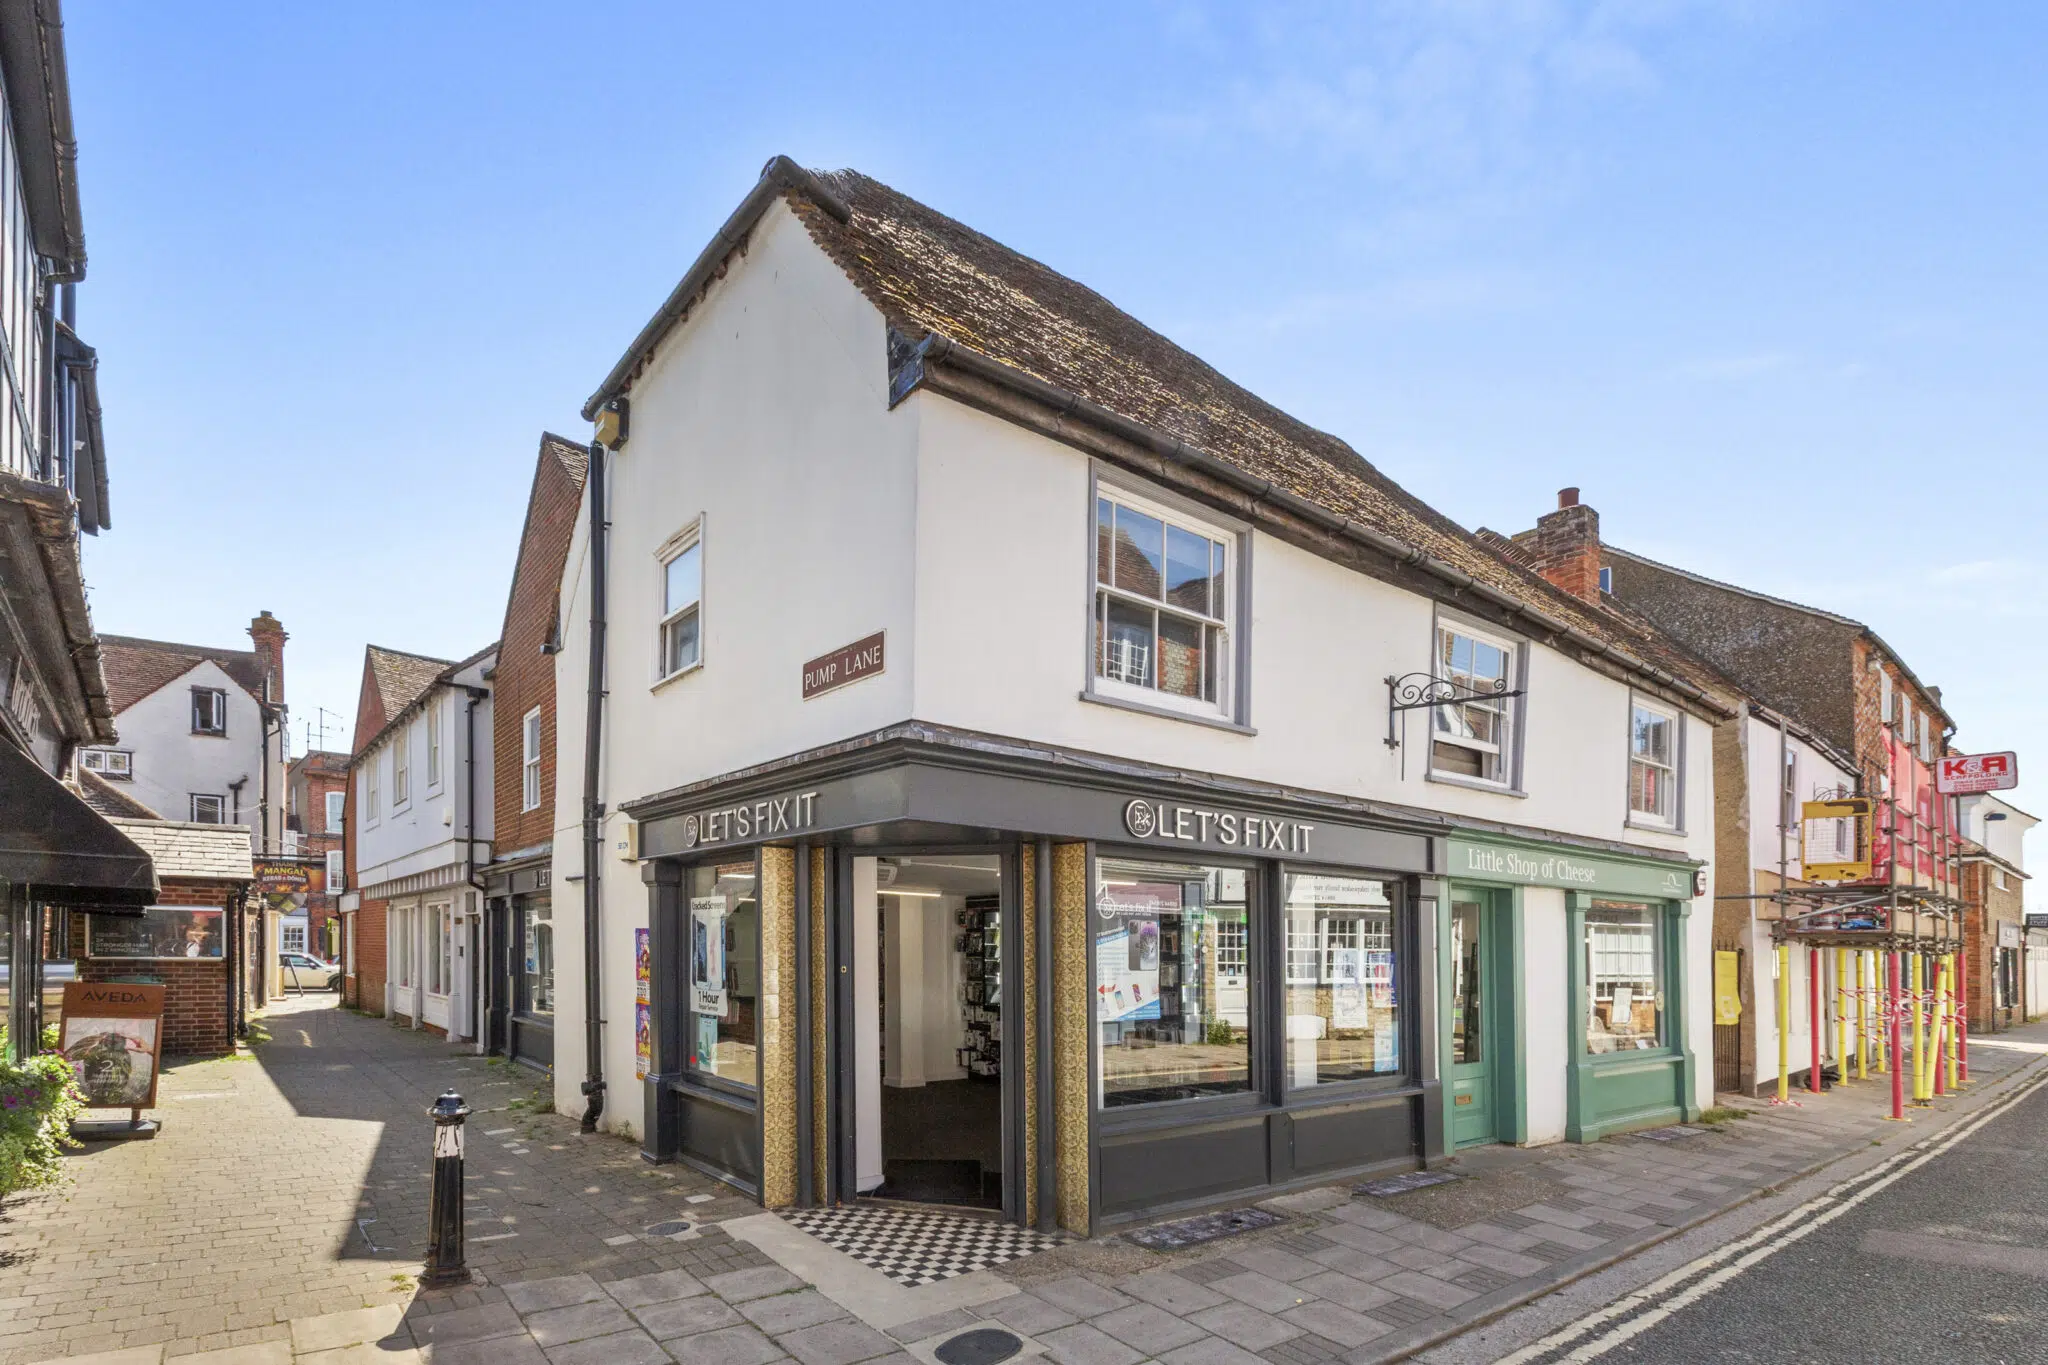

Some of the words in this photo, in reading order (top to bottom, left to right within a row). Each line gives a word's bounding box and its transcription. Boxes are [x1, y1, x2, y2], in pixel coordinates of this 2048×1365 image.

[805, 663, 837, 690] PUMP
[845, 645, 881, 675] LANE
[1944, 756, 2008, 777] K&A
[1944, 772, 2008, 781] SCAFFOLDING
[699, 806, 750, 843] LET'S
[755, 797, 789, 834] FIX
[795, 791, 817, 828] IT
[1157, 804, 1238, 845] LET'S
[1245, 817, 1285, 851] FIX
[1293, 823, 1315, 853] IT
[264, 867, 306, 876] MANGAL
[1467, 848, 1504, 873] Little
[1507, 853, 1537, 881] Shop
[1541, 858, 1555, 878] of
[1556, 860, 1596, 883] Cheese
[81, 990, 147, 1003] AVEDA
[702, 991, 720, 1005] Hour
[100, 1059, 114, 1072] 2
